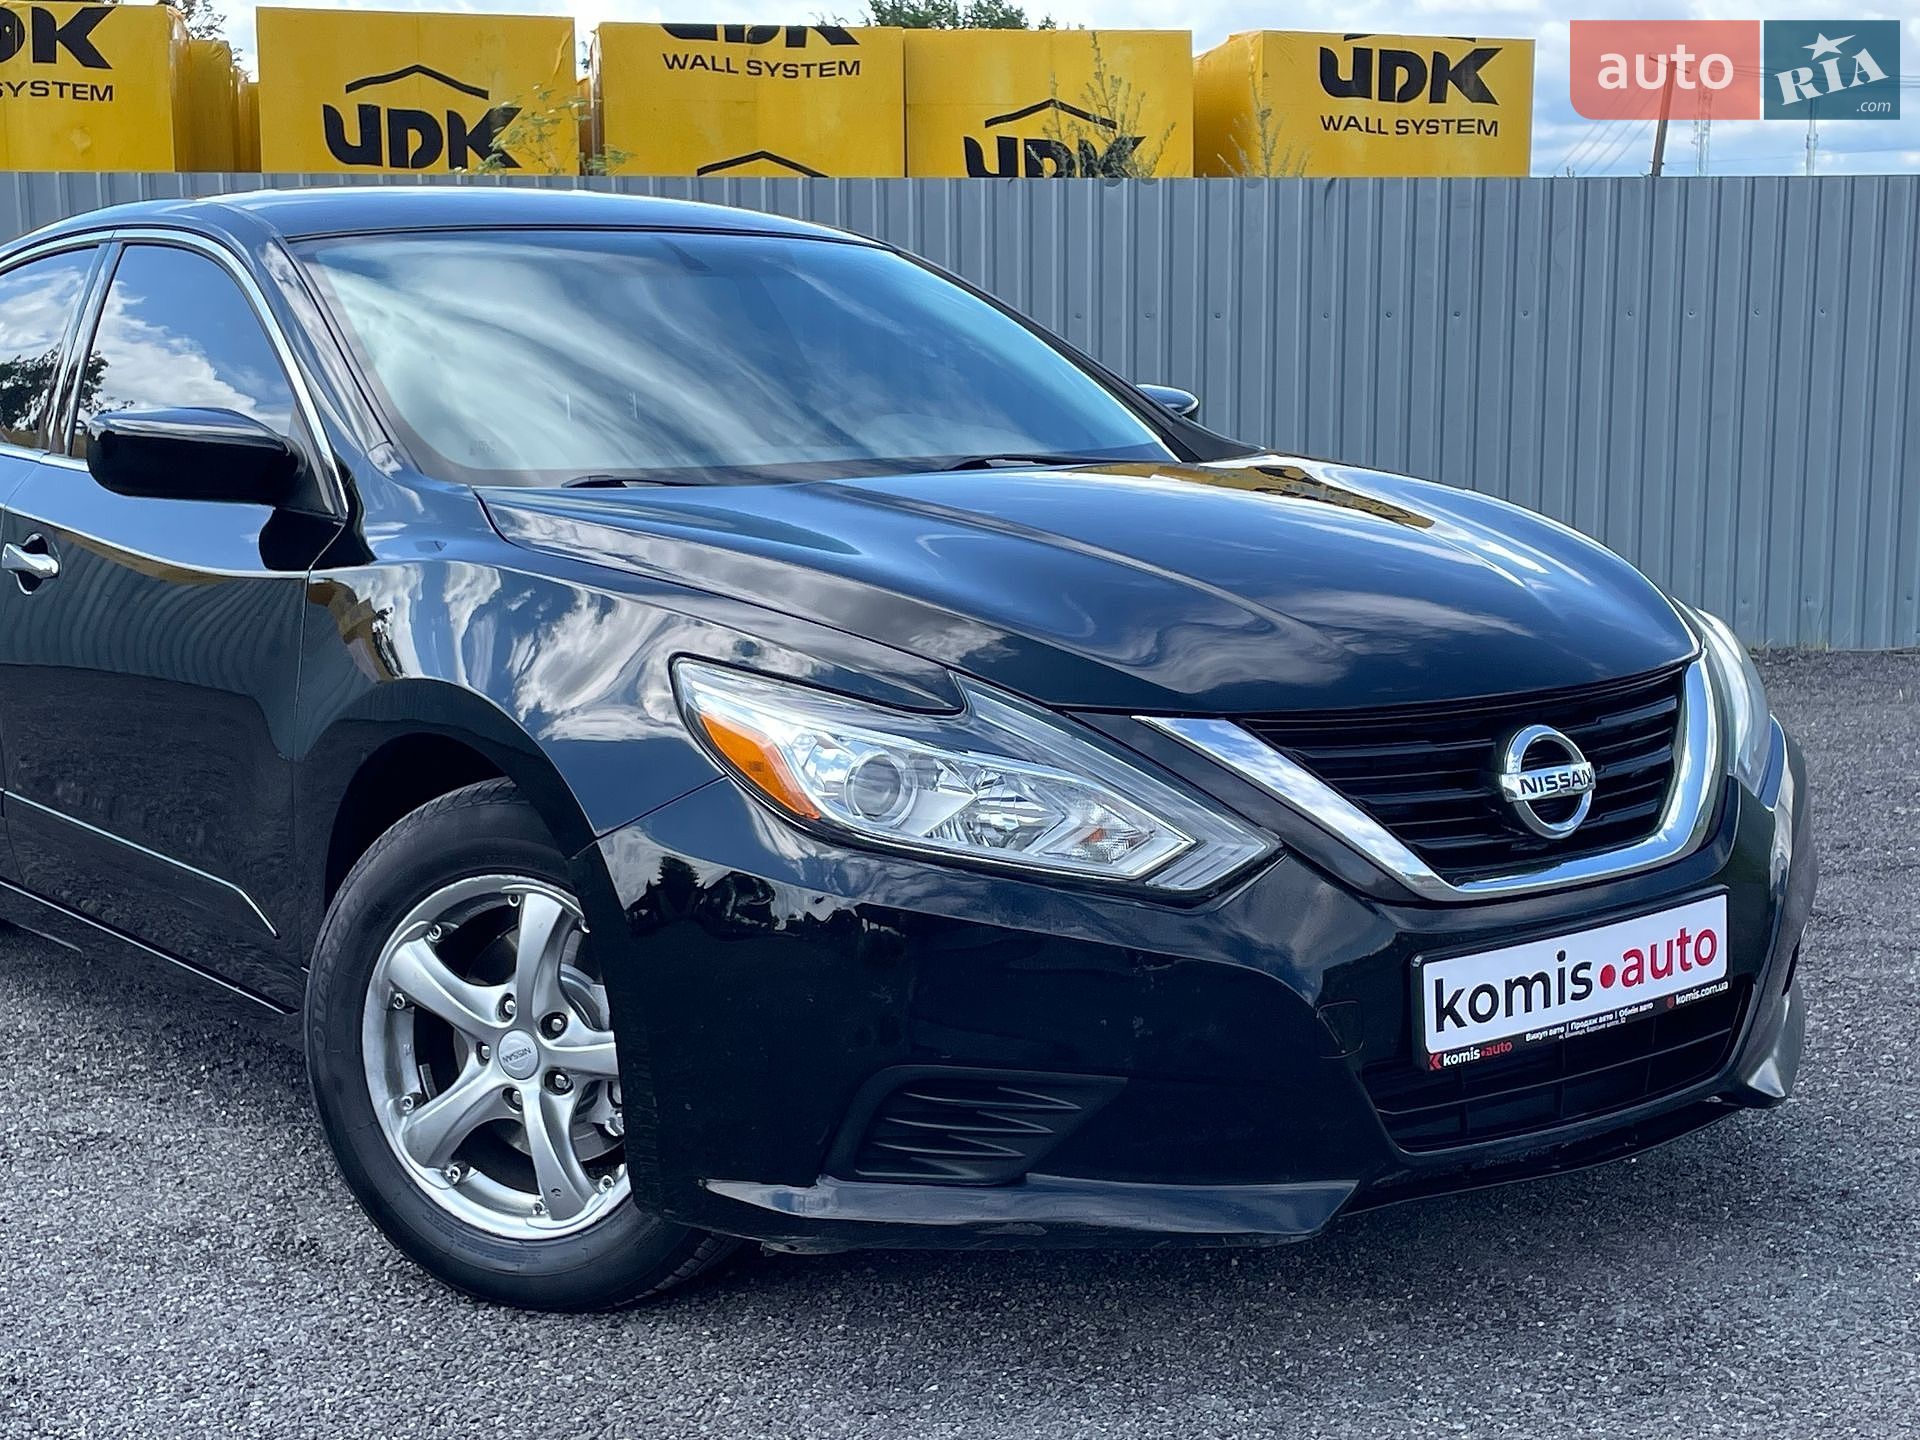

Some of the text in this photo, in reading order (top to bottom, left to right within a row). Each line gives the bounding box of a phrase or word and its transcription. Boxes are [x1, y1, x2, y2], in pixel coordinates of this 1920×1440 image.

[662, 53, 861, 79] WALL SYSTEM
[1319, 46, 1503, 105] UDK
[0, 80, 113, 102] YSTEM
[323, 104, 523, 169] UDK
[1320, 115, 1498, 137] WALL SYSTEM
[1519, 767, 1593, 795] NISSAN
[1675, 981, 1729, 1006] komis.com.ua
